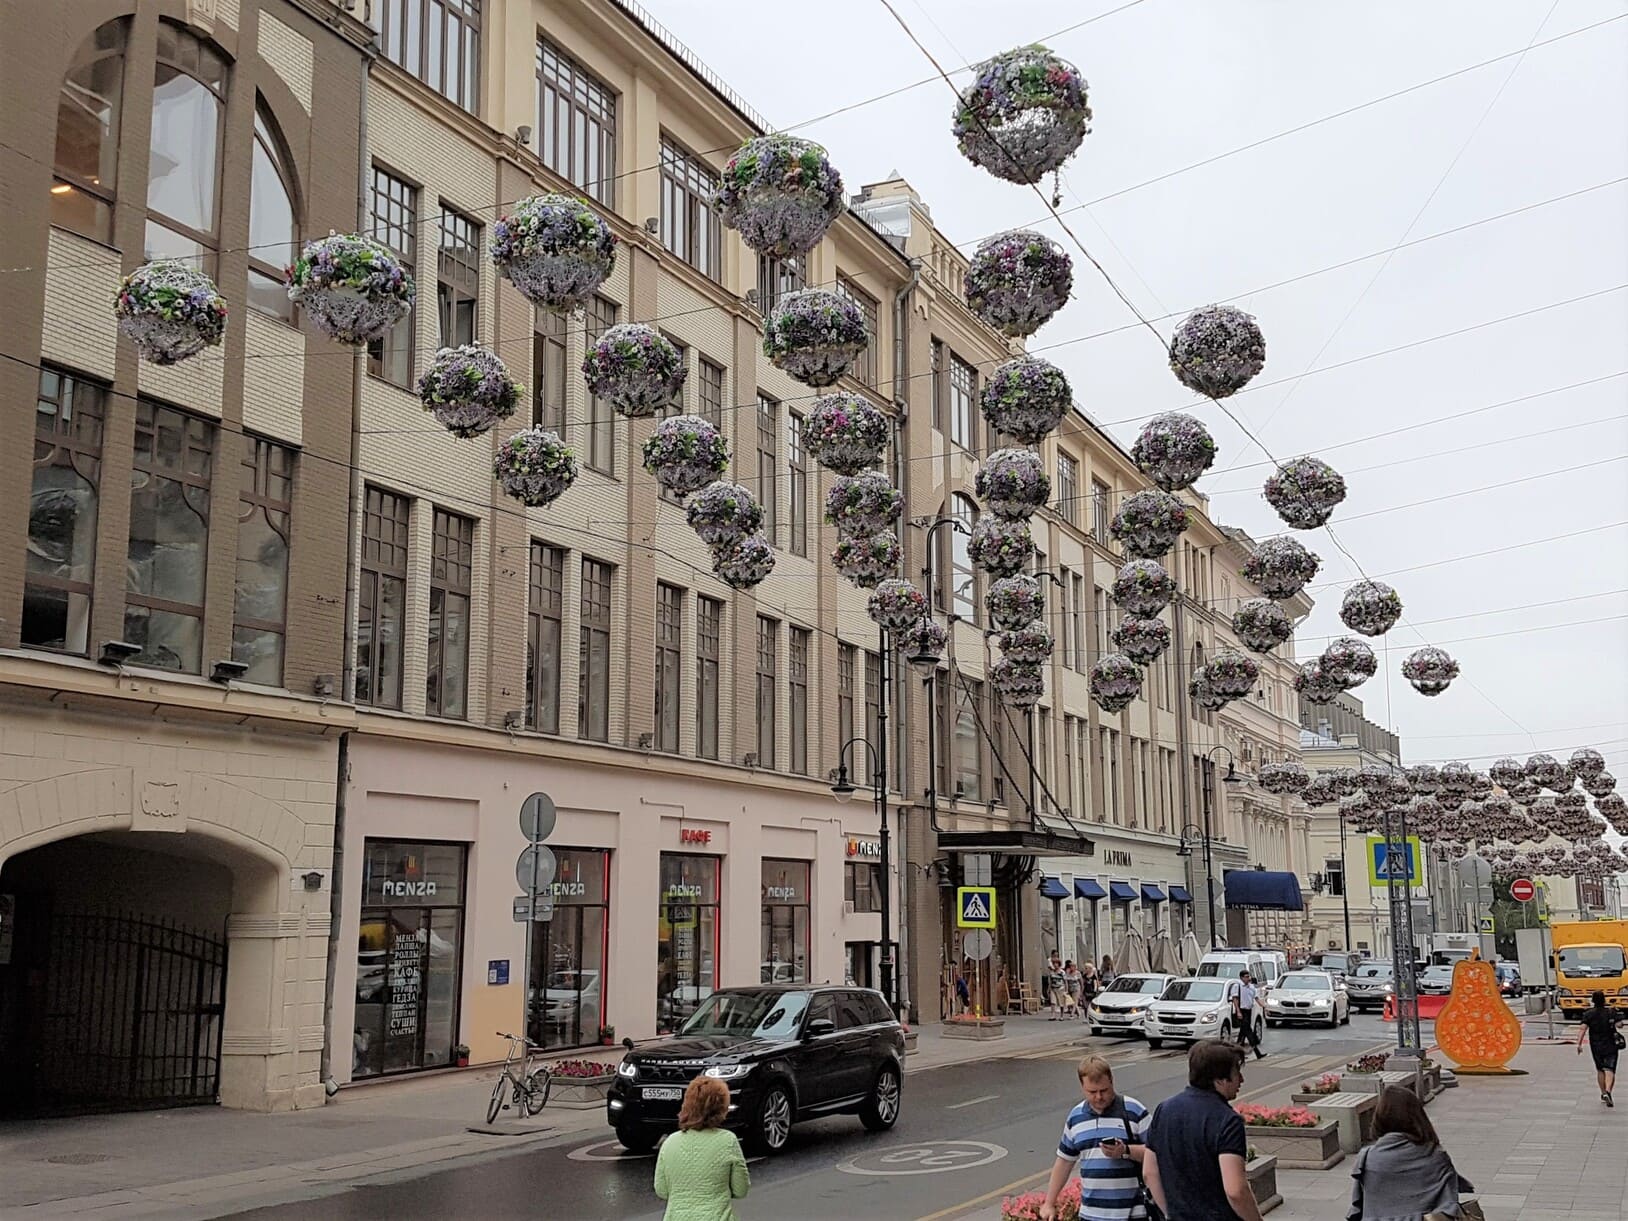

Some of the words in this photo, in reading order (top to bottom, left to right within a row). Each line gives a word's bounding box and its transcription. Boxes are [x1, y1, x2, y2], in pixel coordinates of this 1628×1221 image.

[859, 840, 881, 856] MEN
[382, 880, 437, 896] MENZA
[669, 884, 702, 897] MENZA
[767, 886, 795, 898] MENZA
